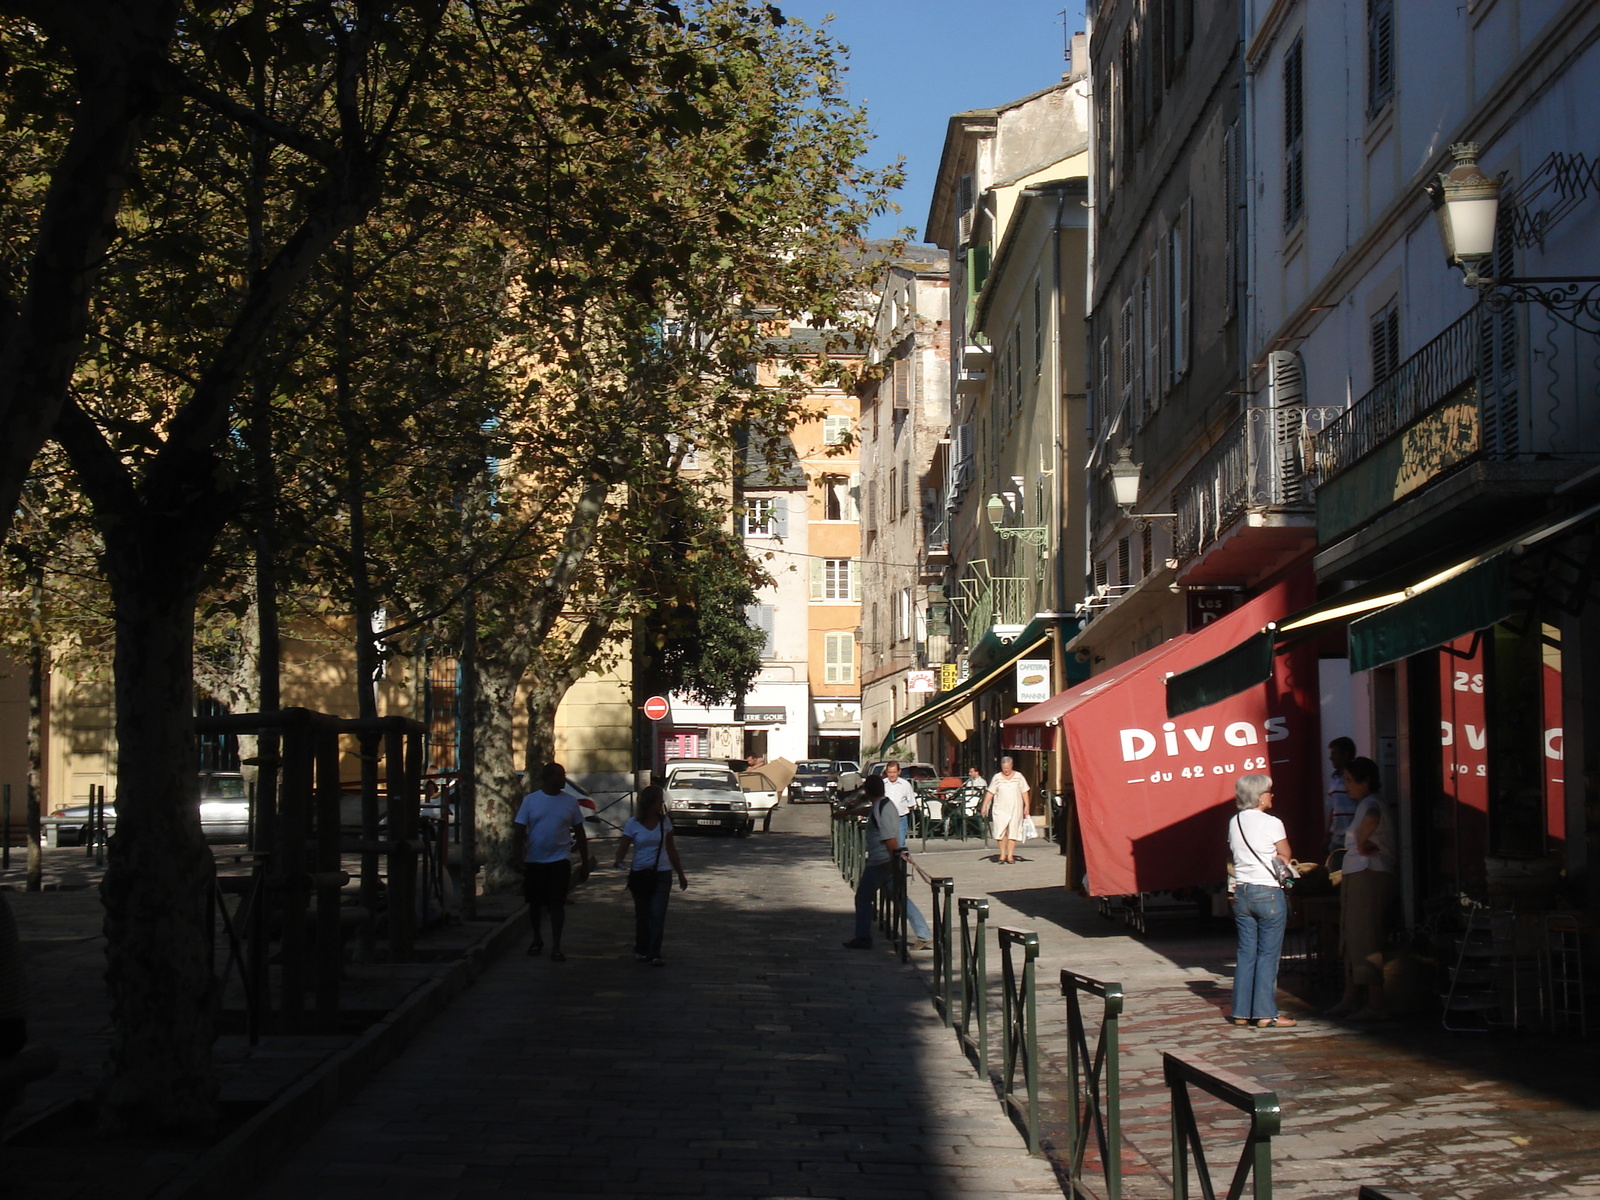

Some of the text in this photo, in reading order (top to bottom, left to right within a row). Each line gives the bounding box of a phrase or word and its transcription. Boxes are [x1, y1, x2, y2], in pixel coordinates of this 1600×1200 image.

[1198, 597, 1222, 609] Les
[1120, 716, 1290, 762] Divas
[1150, 756, 1267, 783] du 42 au 62
